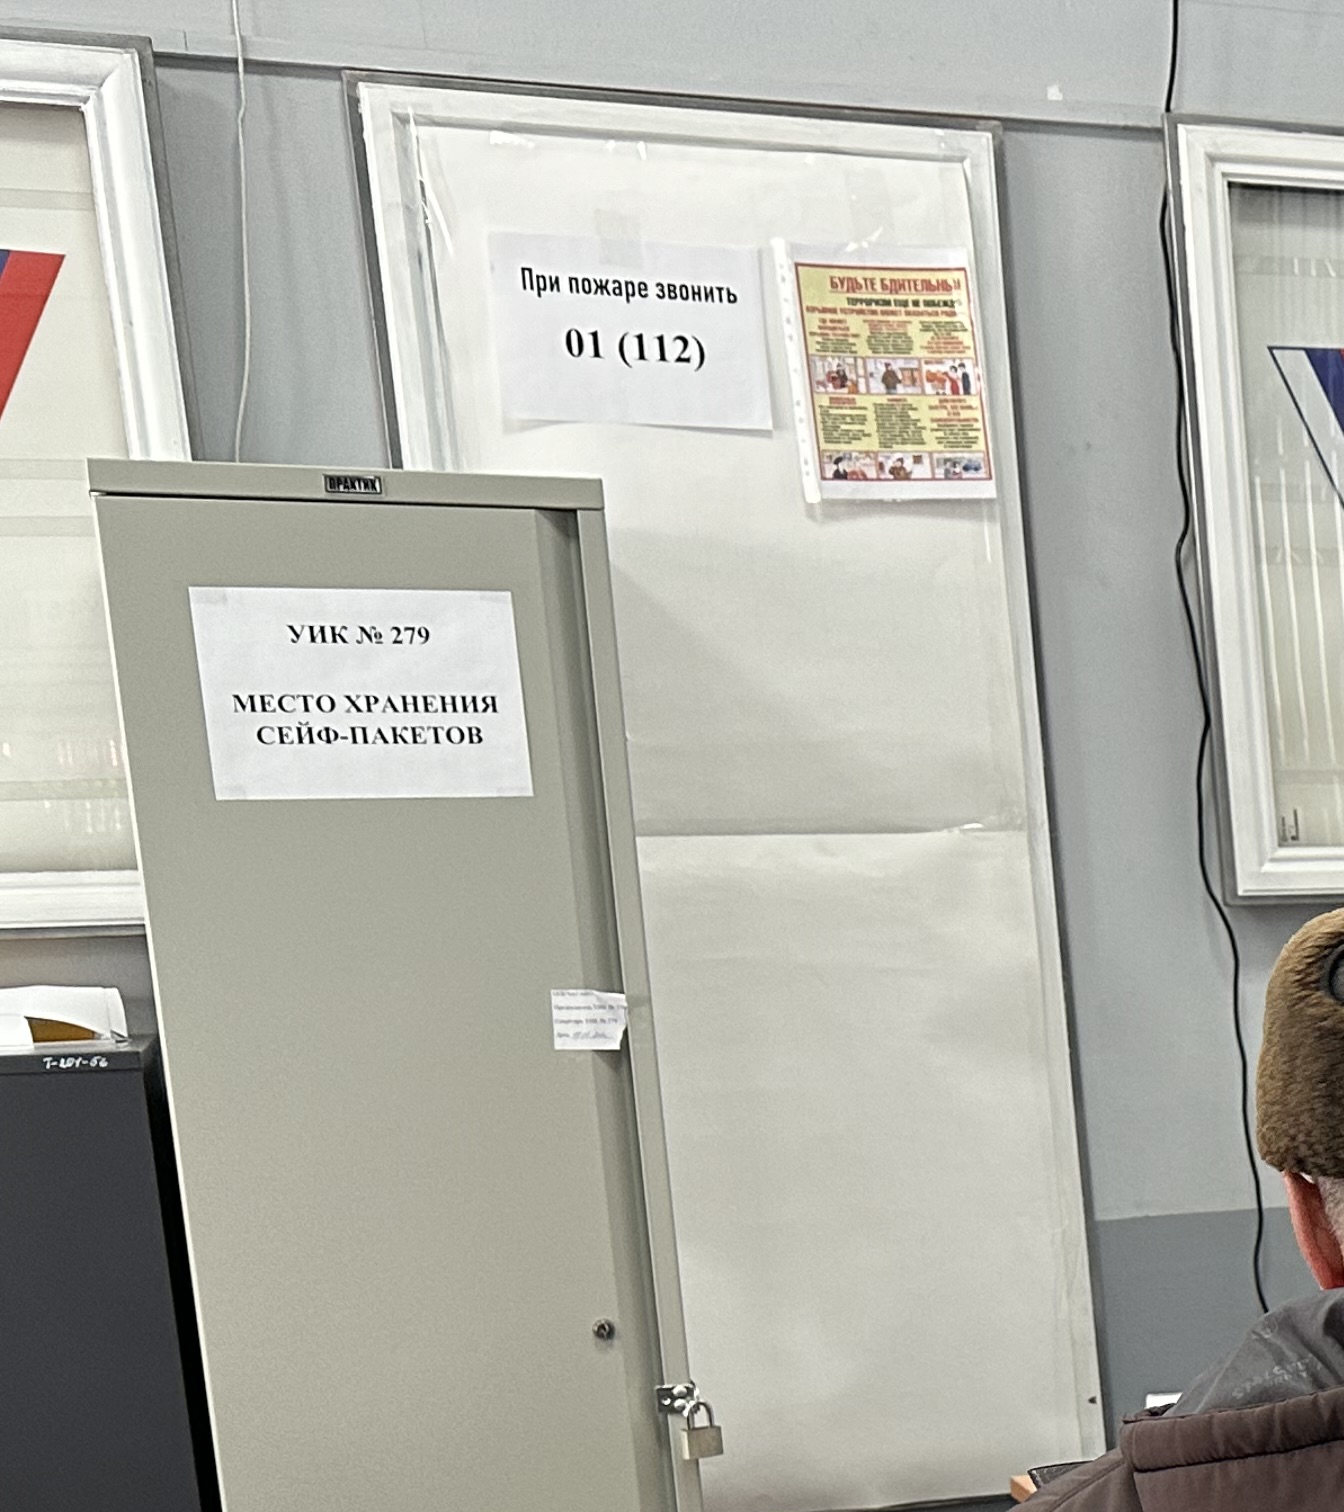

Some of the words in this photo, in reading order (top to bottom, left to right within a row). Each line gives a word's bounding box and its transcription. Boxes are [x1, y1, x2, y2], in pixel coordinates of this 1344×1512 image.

[520, 266, 561, 299] При
[568, 275, 649, 304] пожаре
[655, 281, 739, 305] звонить
[830, 275, 877, 293] БУДЬТЕ
[565, 327, 606, 360] 01
[618, 331, 706, 372] (112)
[286, 624, 350, 645] УИК
[355, 625, 384, 645] №
[391, 625, 431, 646] 279
[231, 693, 337, 714] МЕСТО
[343, 693, 500, 714] ХРАНЕНИЯ
[256, 721, 485, 746] СЕЙФ-ПАКЕТОВ
